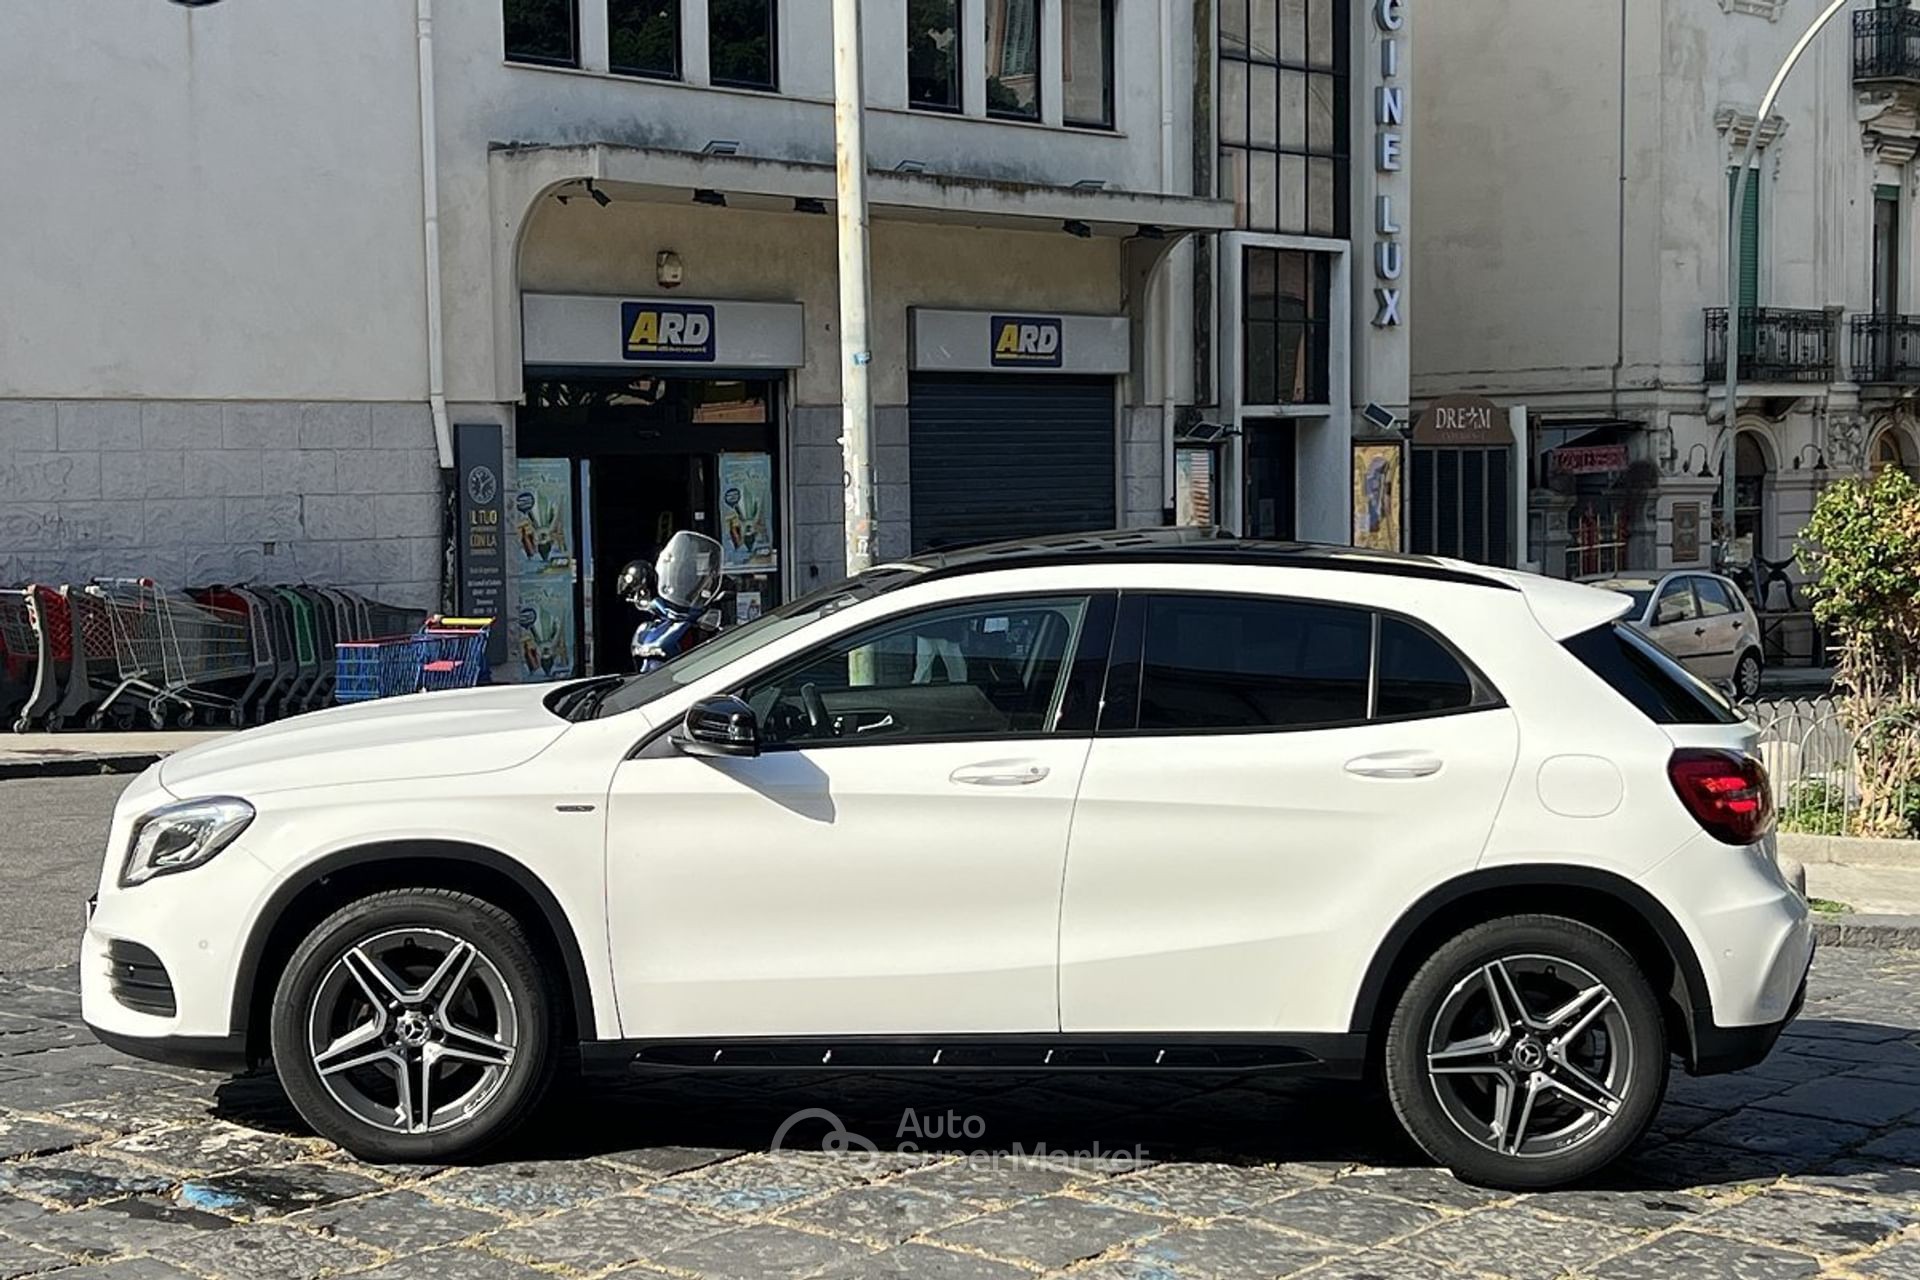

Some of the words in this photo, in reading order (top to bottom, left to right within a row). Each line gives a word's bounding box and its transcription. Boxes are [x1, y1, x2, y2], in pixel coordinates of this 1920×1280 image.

[1375, 0, 1402, 326] CINELUX
[628, 311, 710, 345] ARD
[996, 324, 1059, 353] ARD
